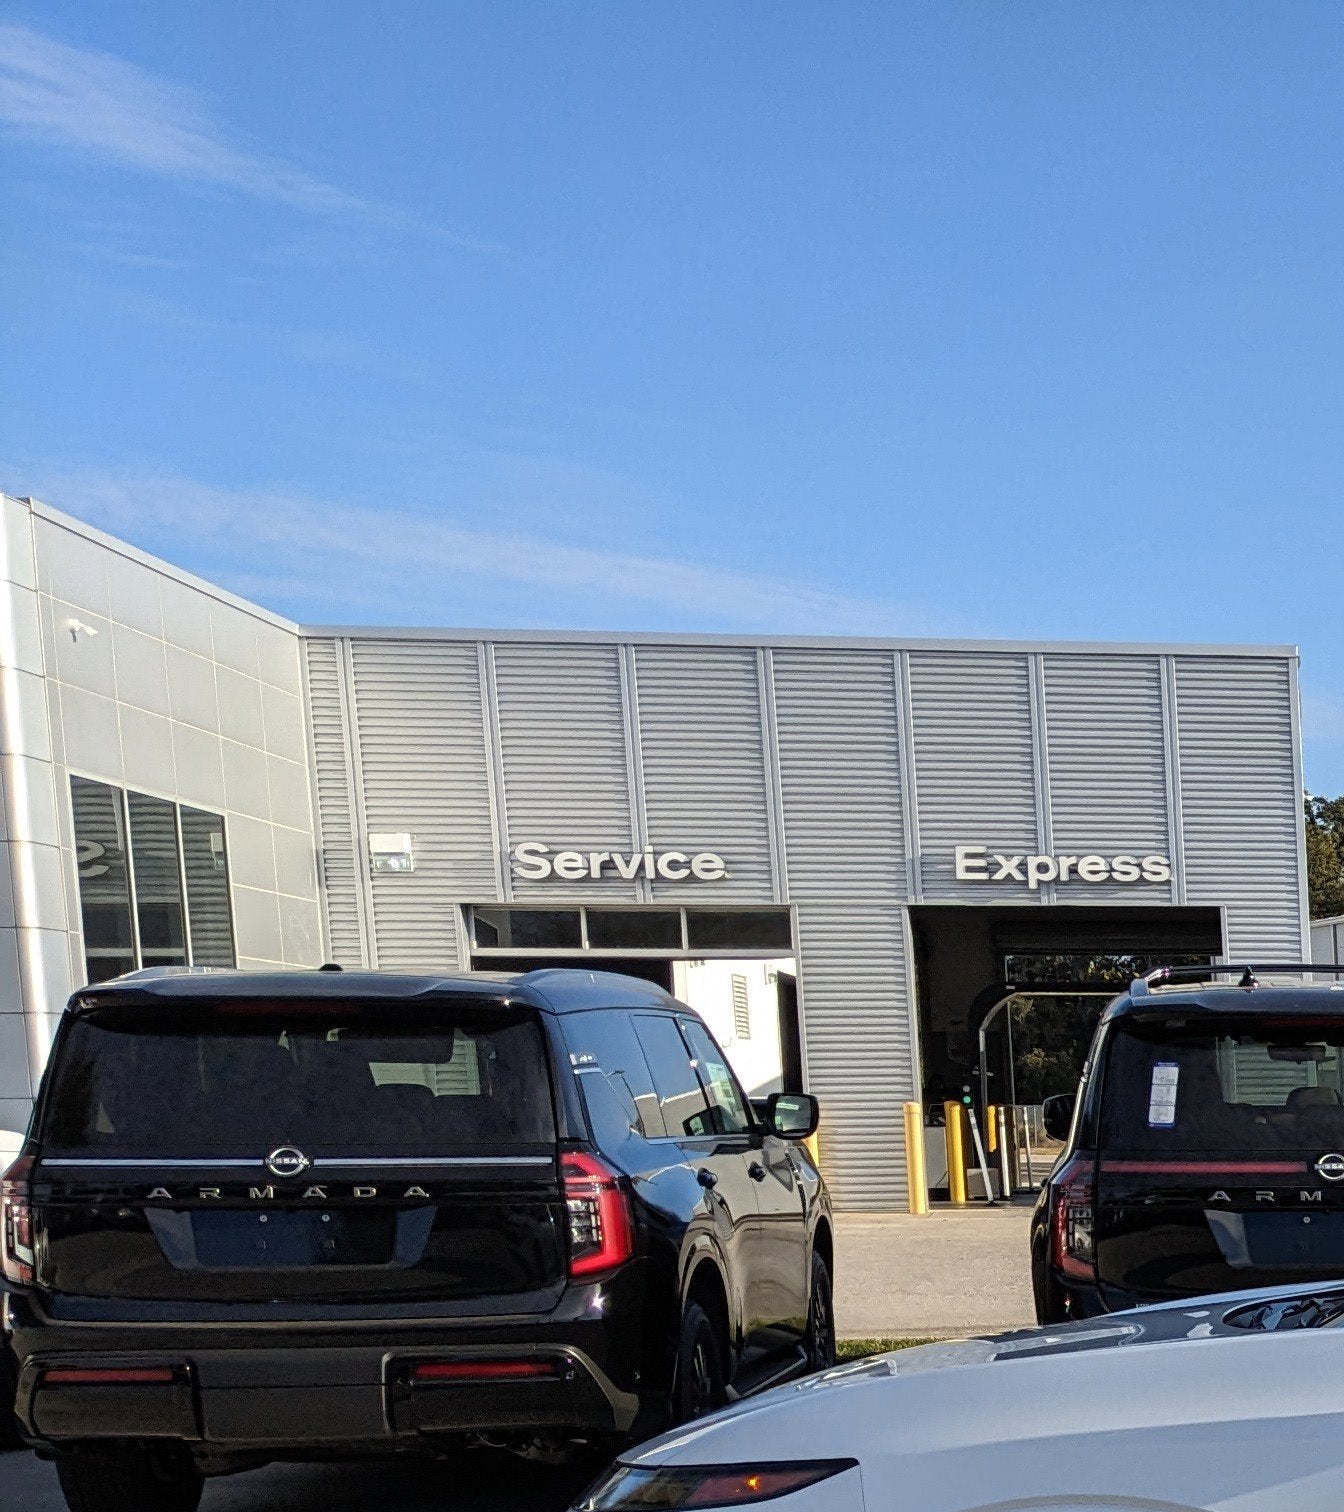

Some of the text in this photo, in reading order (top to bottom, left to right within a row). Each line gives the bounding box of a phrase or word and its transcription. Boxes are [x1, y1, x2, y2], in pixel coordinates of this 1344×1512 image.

[514, 842, 726, 880] Service
[955, 845, 1171, 889] Express
[264, 1157, 309, 1167] NISSAN
[146, 1185, 430, 1199] ARMADA
